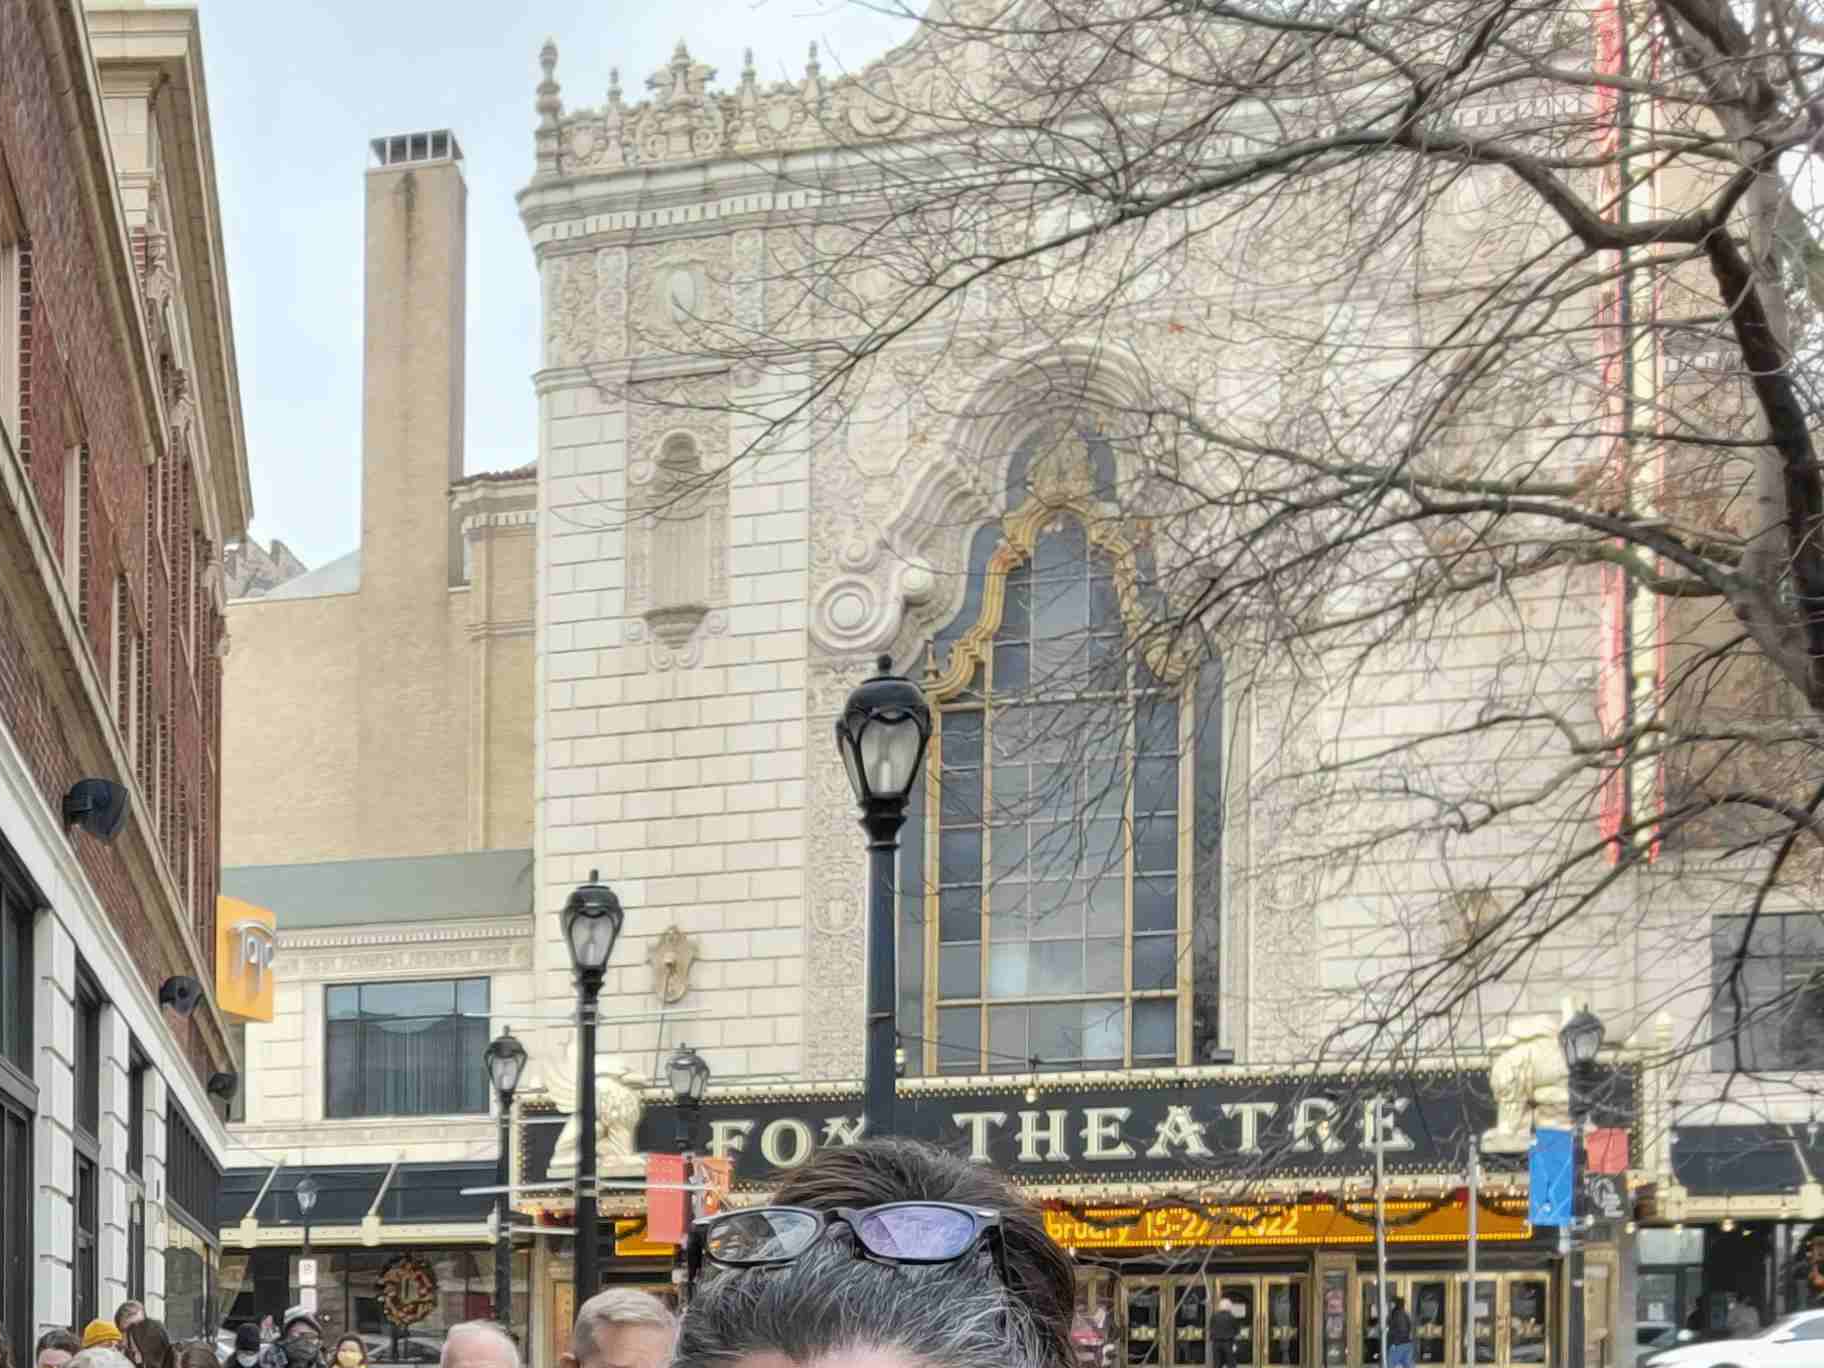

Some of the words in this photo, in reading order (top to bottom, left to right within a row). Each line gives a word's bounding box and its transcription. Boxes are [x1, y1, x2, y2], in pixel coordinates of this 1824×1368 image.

[706, 1112, 865, 1168] FOX
[952, 1097, 1415, 1165] THEATRE
[1043, 1208, 1130, 1244] bruary
